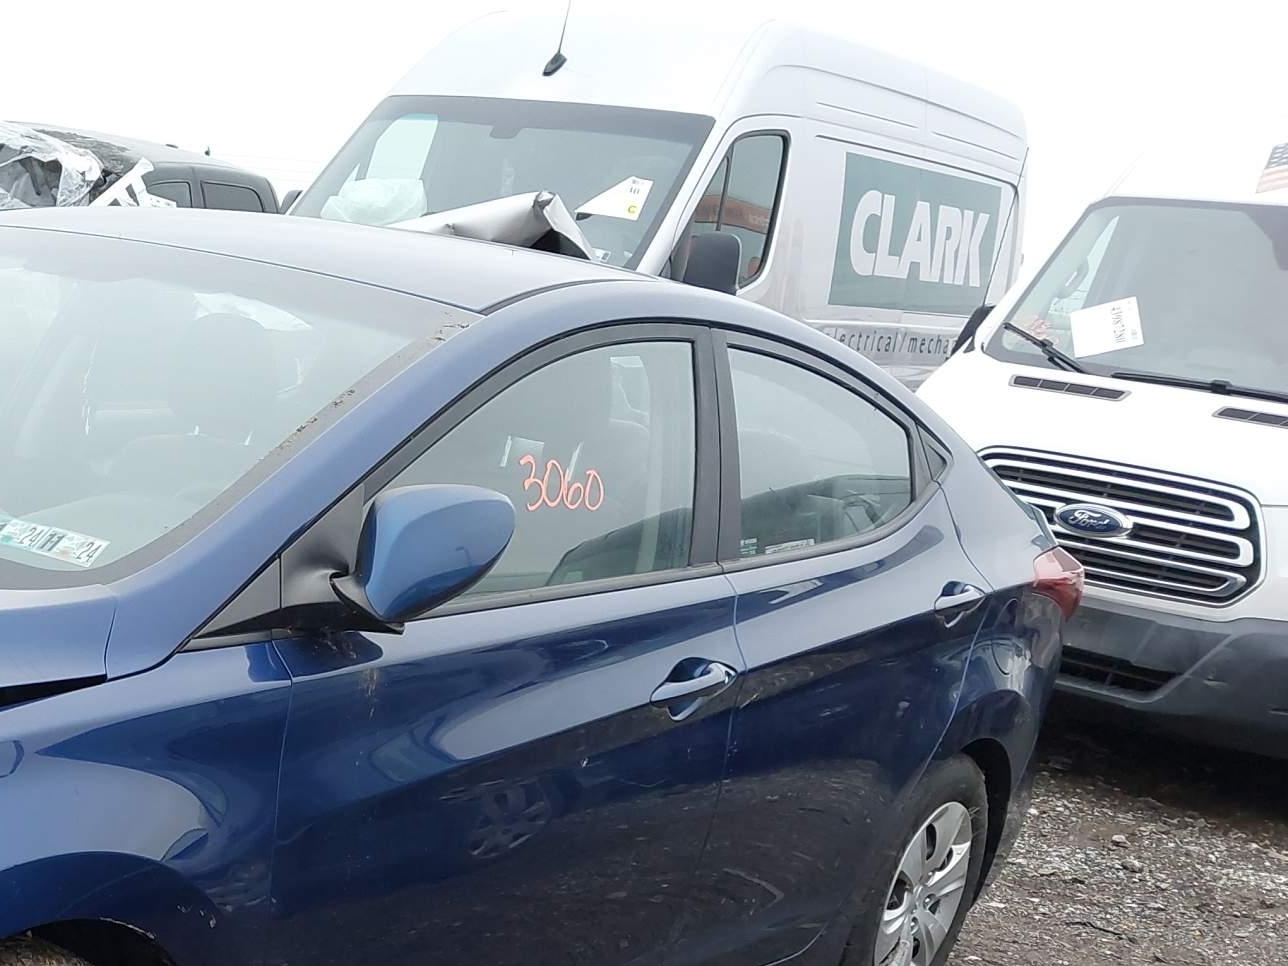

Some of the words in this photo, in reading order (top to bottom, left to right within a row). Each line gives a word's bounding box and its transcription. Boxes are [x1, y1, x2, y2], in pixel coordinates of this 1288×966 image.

[850, 190, 990, 287] CLARK
[825, 328, 958, 354] lectrical/mecha
[519, 454, 605, 511] 3060
[1068, 509, 1111, 530] Ford
